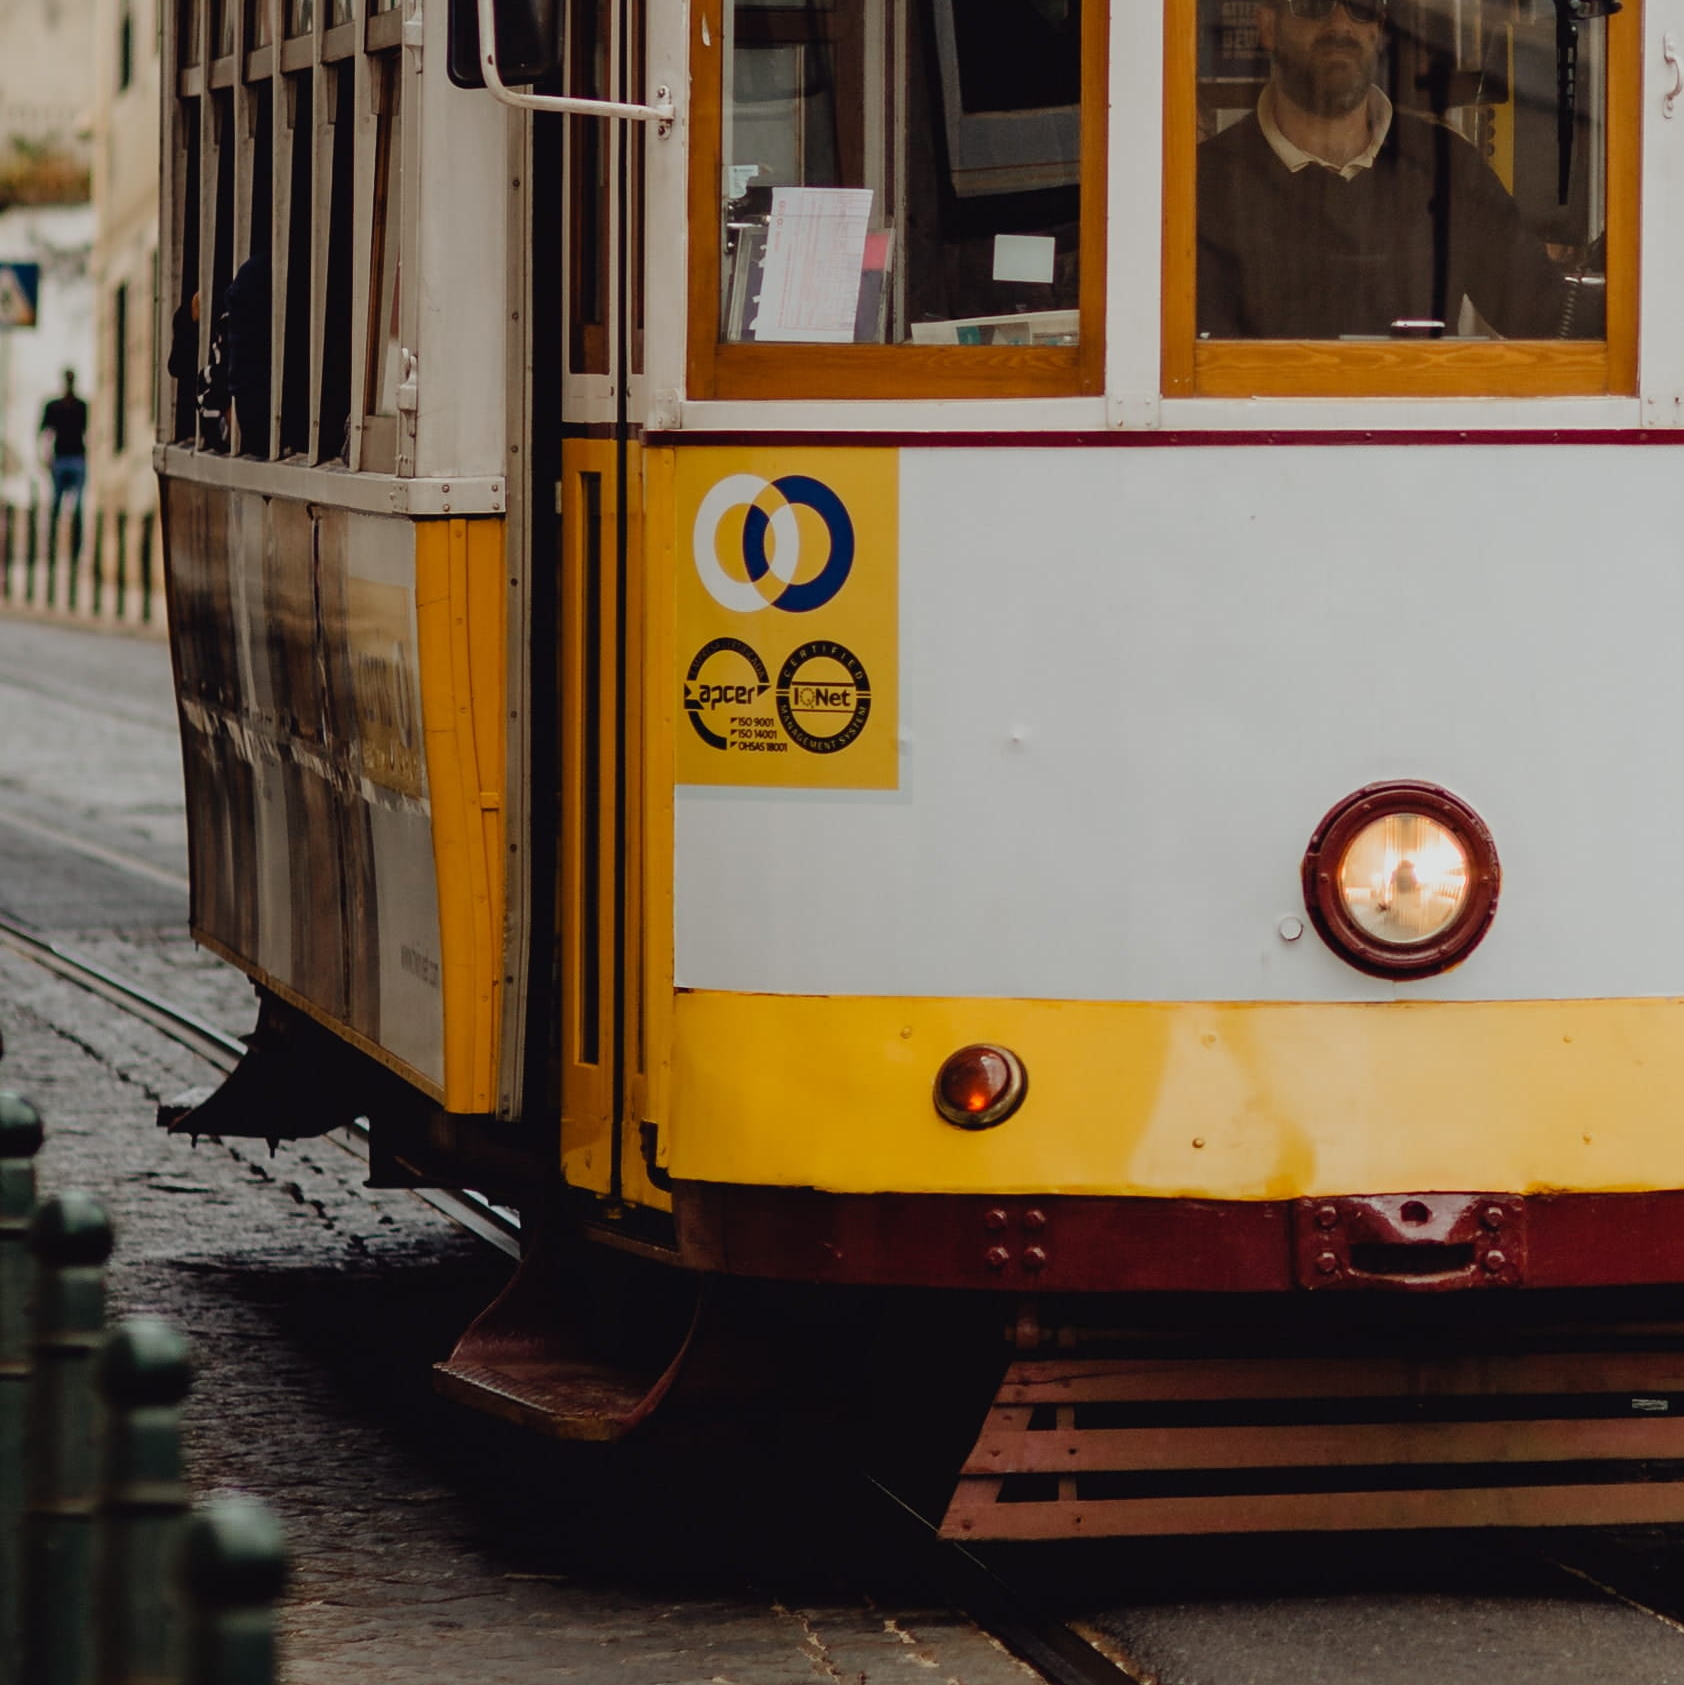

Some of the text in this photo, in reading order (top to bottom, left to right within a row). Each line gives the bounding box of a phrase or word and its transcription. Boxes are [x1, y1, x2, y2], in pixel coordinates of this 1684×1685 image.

[783, 644, 864, 680] CERTIFIED
[699, 684, 756, 710] apcer
[793, 687, 851, 709] IQNet
[738, 717, 774, 727] ISO 9001
[780, 704, 867, 750] MANAGEMENT SYSTEM
[738, 729, 777, 739] ISO 14001
[738, 741, 765, 751] OHSAS
